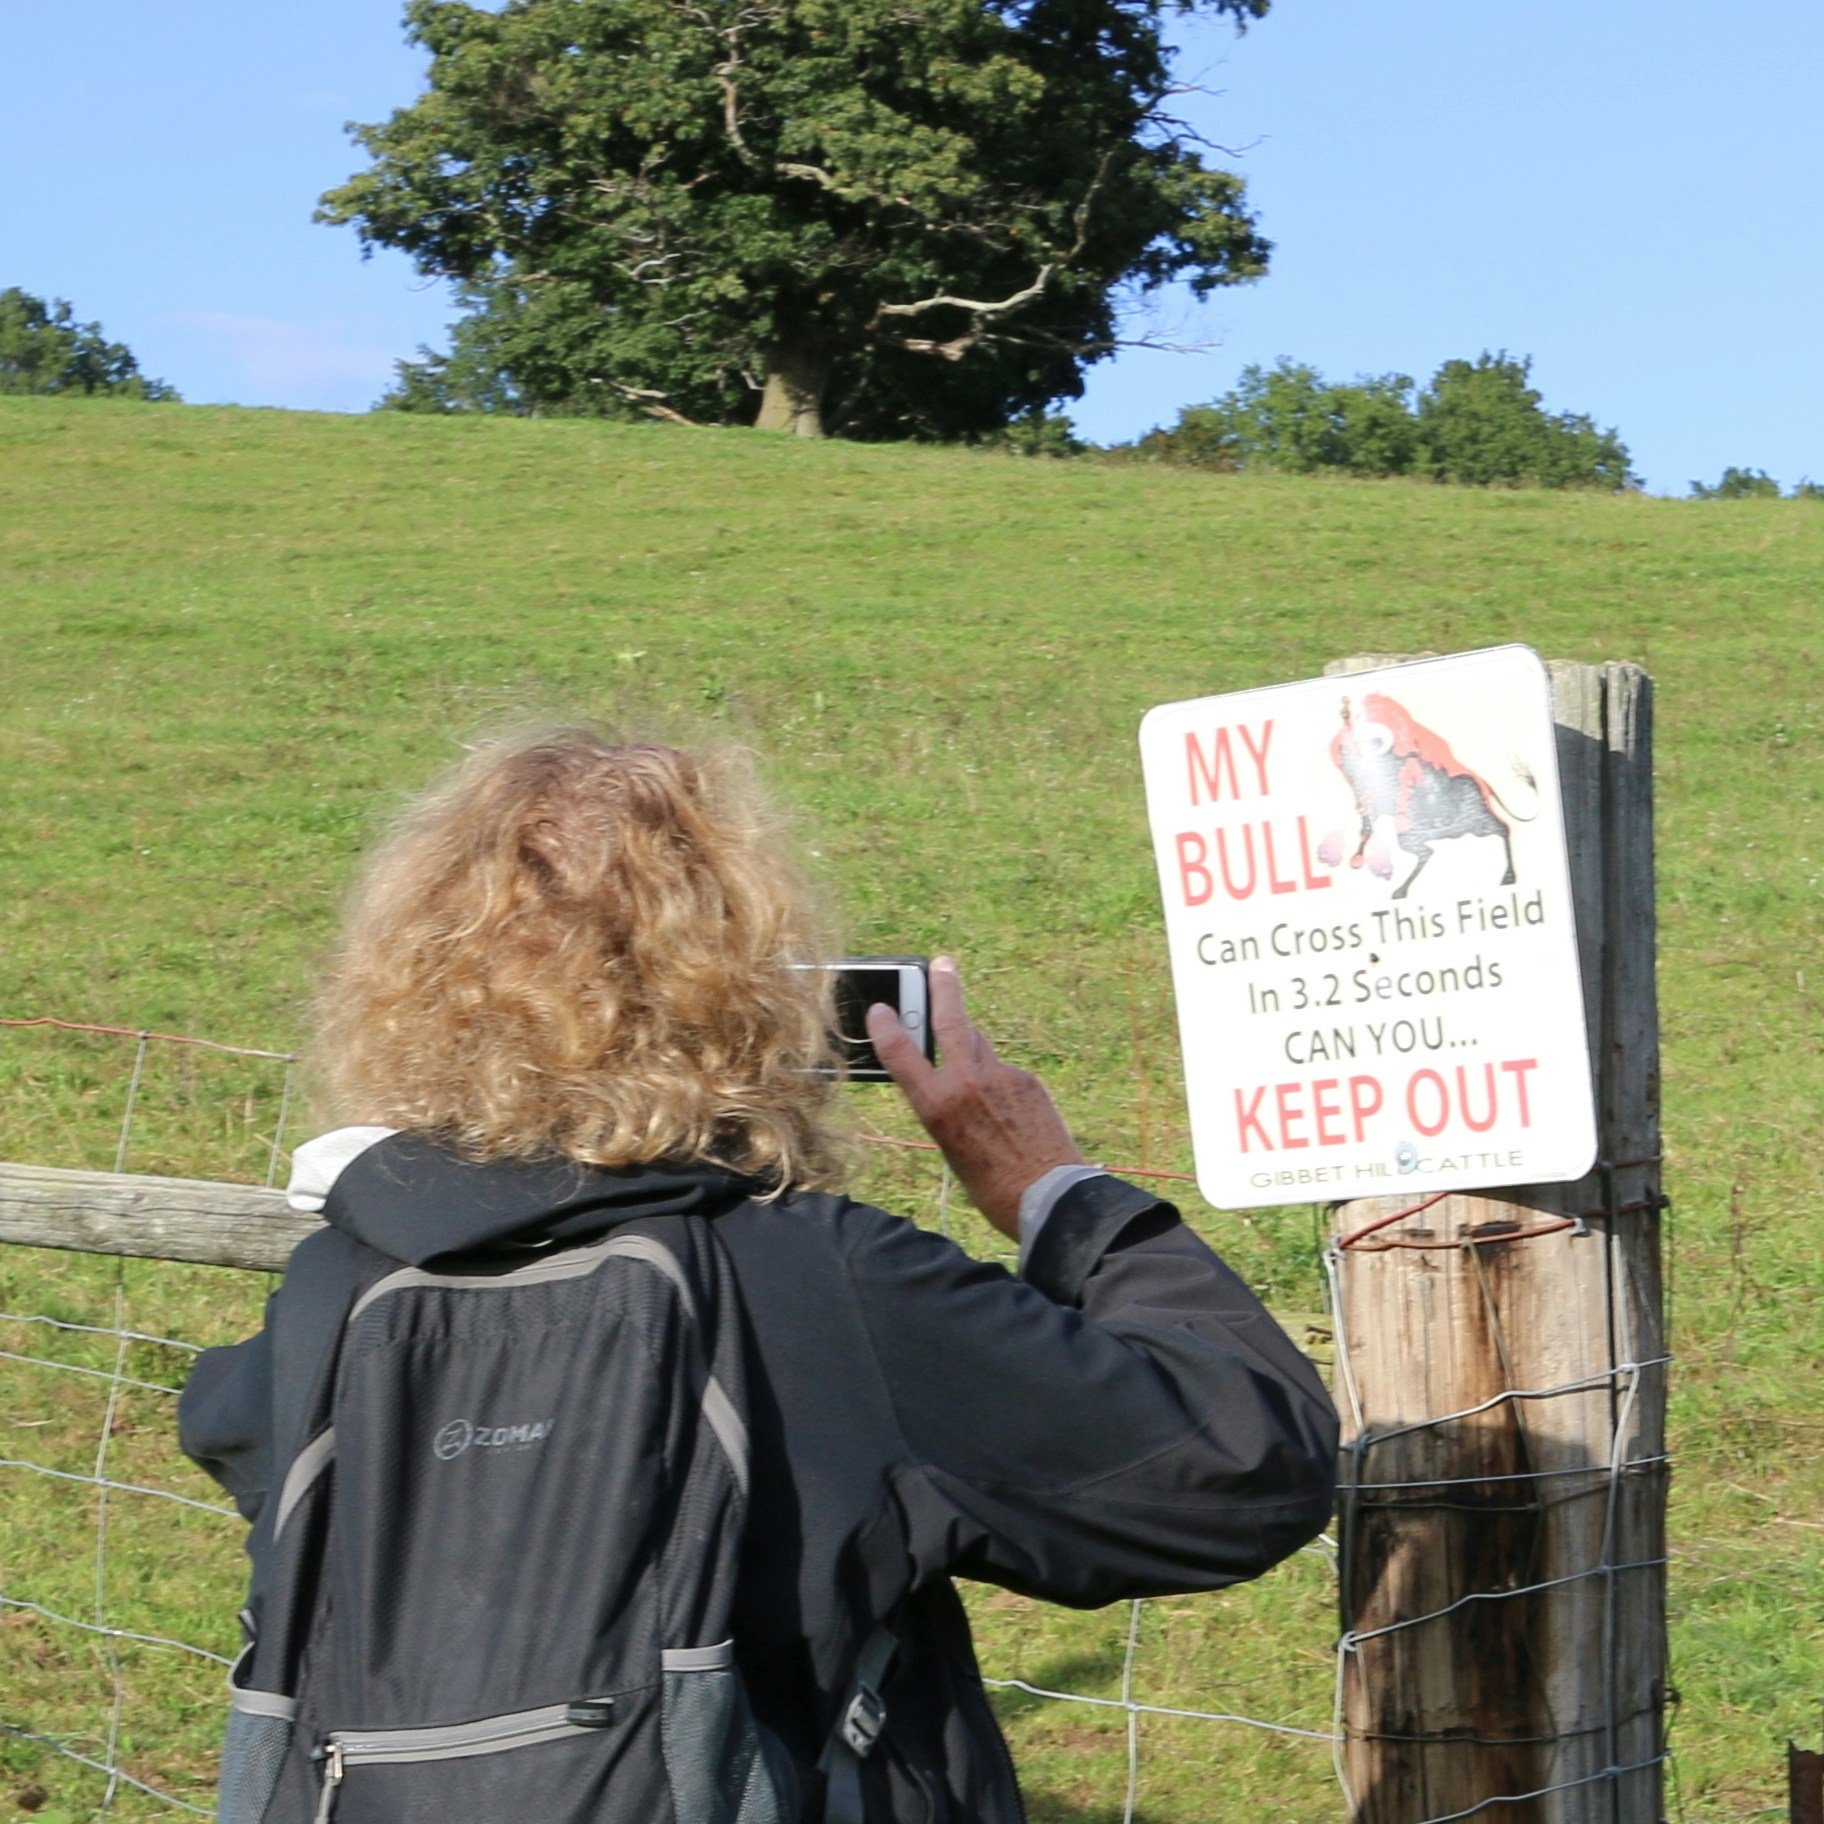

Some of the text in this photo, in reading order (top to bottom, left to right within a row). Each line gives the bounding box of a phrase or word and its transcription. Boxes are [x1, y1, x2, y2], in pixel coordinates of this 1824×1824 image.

[1184, 719, 1275, 807] MY
[1174, 815, 1334, 908] BULL
[1196, 888, 1546, 966] Can Cross This Field
[1248, 953, 1504, 1015] In 3.2 Seconds
[1284, 1015, 1480, 1065] CAN YOU...
[1233, 1057, 1539, 1154] KEEP OUT
[1249, 1150, 1524, 1188] GIBBET HIL CATTLE
